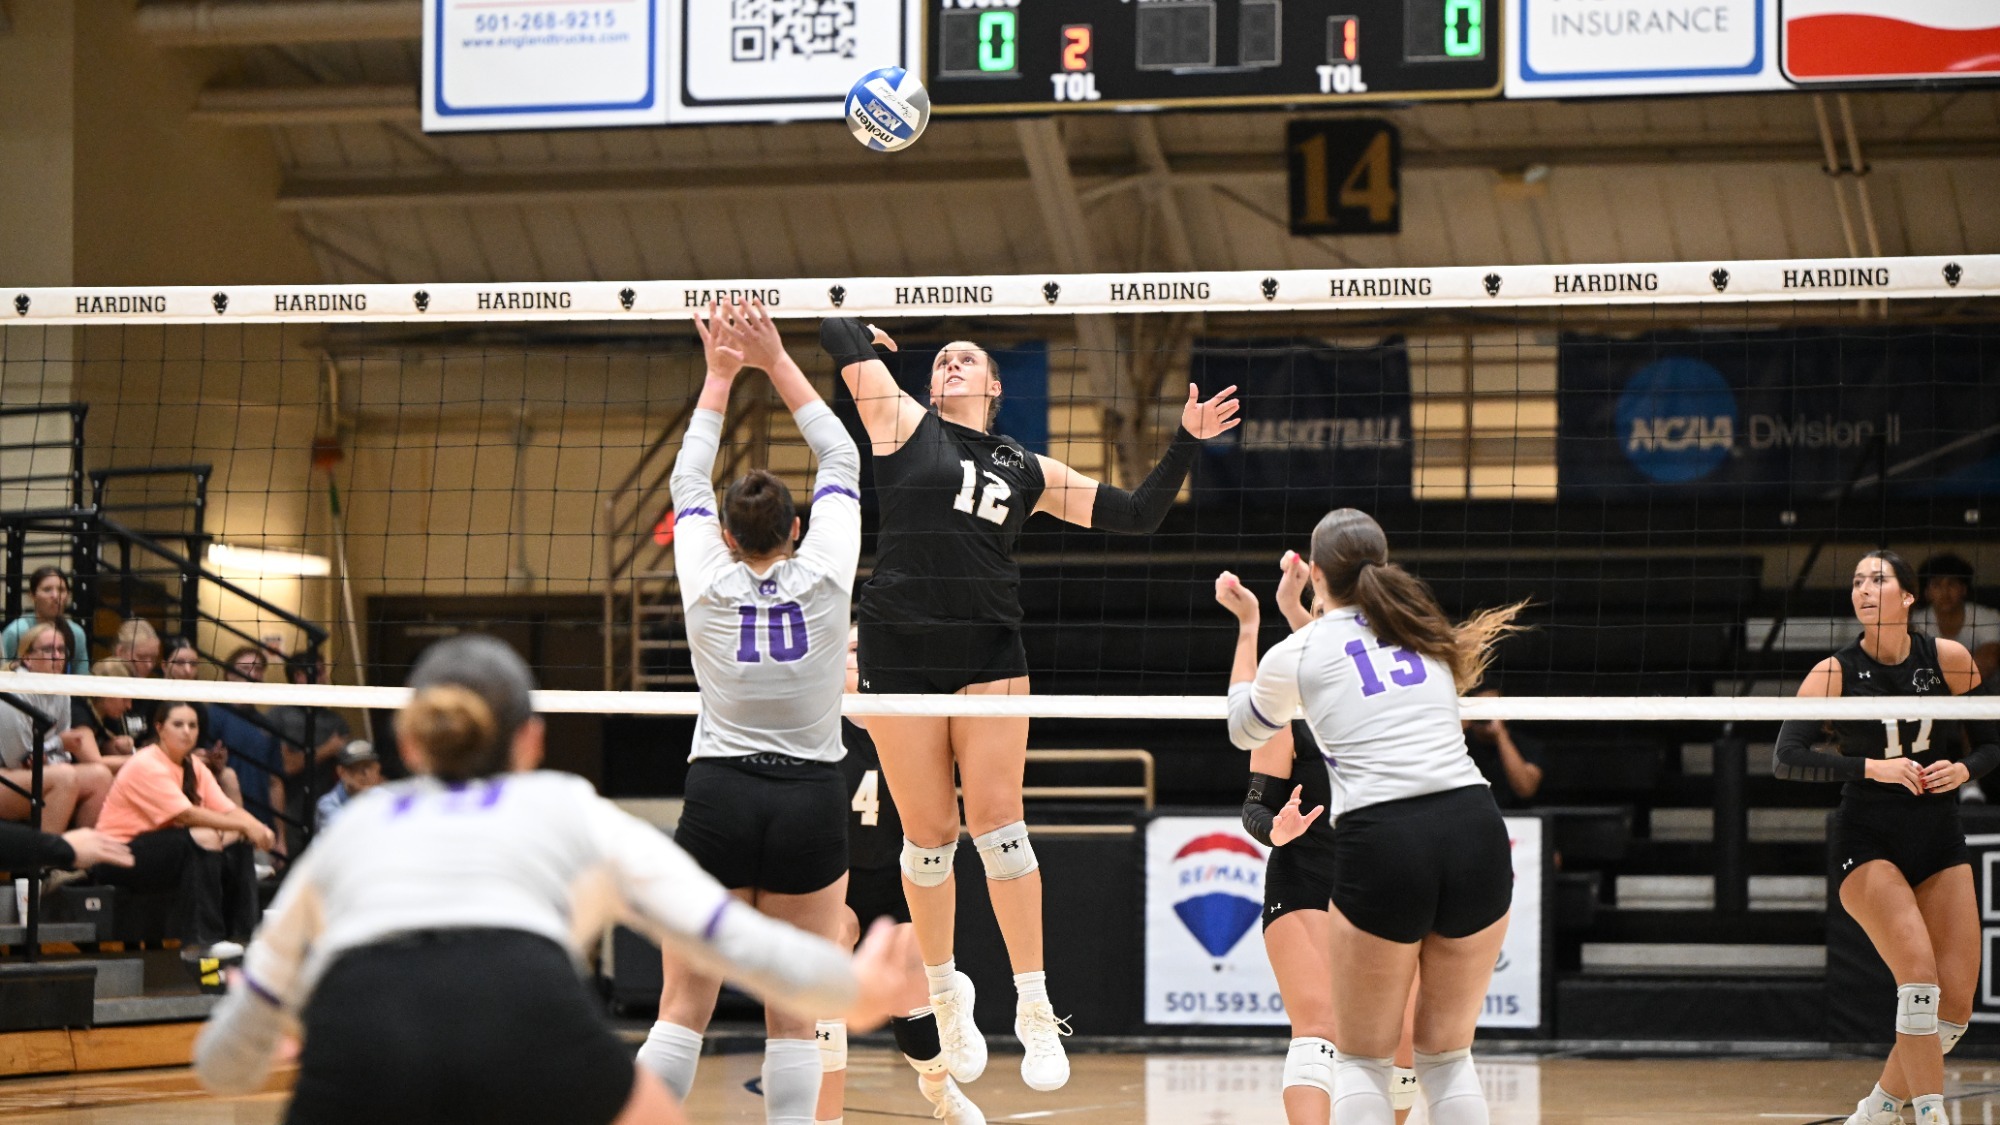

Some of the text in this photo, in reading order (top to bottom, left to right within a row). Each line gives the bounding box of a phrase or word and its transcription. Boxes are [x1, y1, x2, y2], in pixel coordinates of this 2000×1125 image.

[475, 10, 616, 32] 501-268-9215
[1444, 0, 1481, 56] 0
[1552, 6, 1729, 36] INSURANCE
[979, 11, 1015, 71] 0
[1063, 27, 1091, 70] 2
[1344, 19, 1356, 61] 1
[1050, 72, 1101, 101] TOL
[1316, 64, 1368, 93] TOL
[855, 107, 894, 143] molten
[866, 98, 903, 132] NCAA
[1297, 131, 1396, 224] 14
[1111, 282, 1210, 300] HARDING
[1330, 278, 1432, 297] HARDING
[1554, 273, 1658, 293] HARDING
[1783, 267, 1889, 288] HARDING
[76, 296, 166, 312] HARDING
[275, 295, 366, 310] HARDING
[478, 292, 571, 309] HARDING
[895, 286, 992, 304] HARDING
[1241, 418, 1400, 450] BASKETBALL
[1628, 415, 1734, 451] NCAA
[1750, 412, 1874, 449] Division
[953, 459, 1012, 526] 12
[736, 601, 808, 663] 10
[1345, 638, 1428, 698] 13
[1881, 718, 1934, 759] 17
[851, 770, 881, 827] 4
[1179, 864, 1260, 887] RE/MAX
[1165, 992, 1520, 1016] 501.593.0 115
